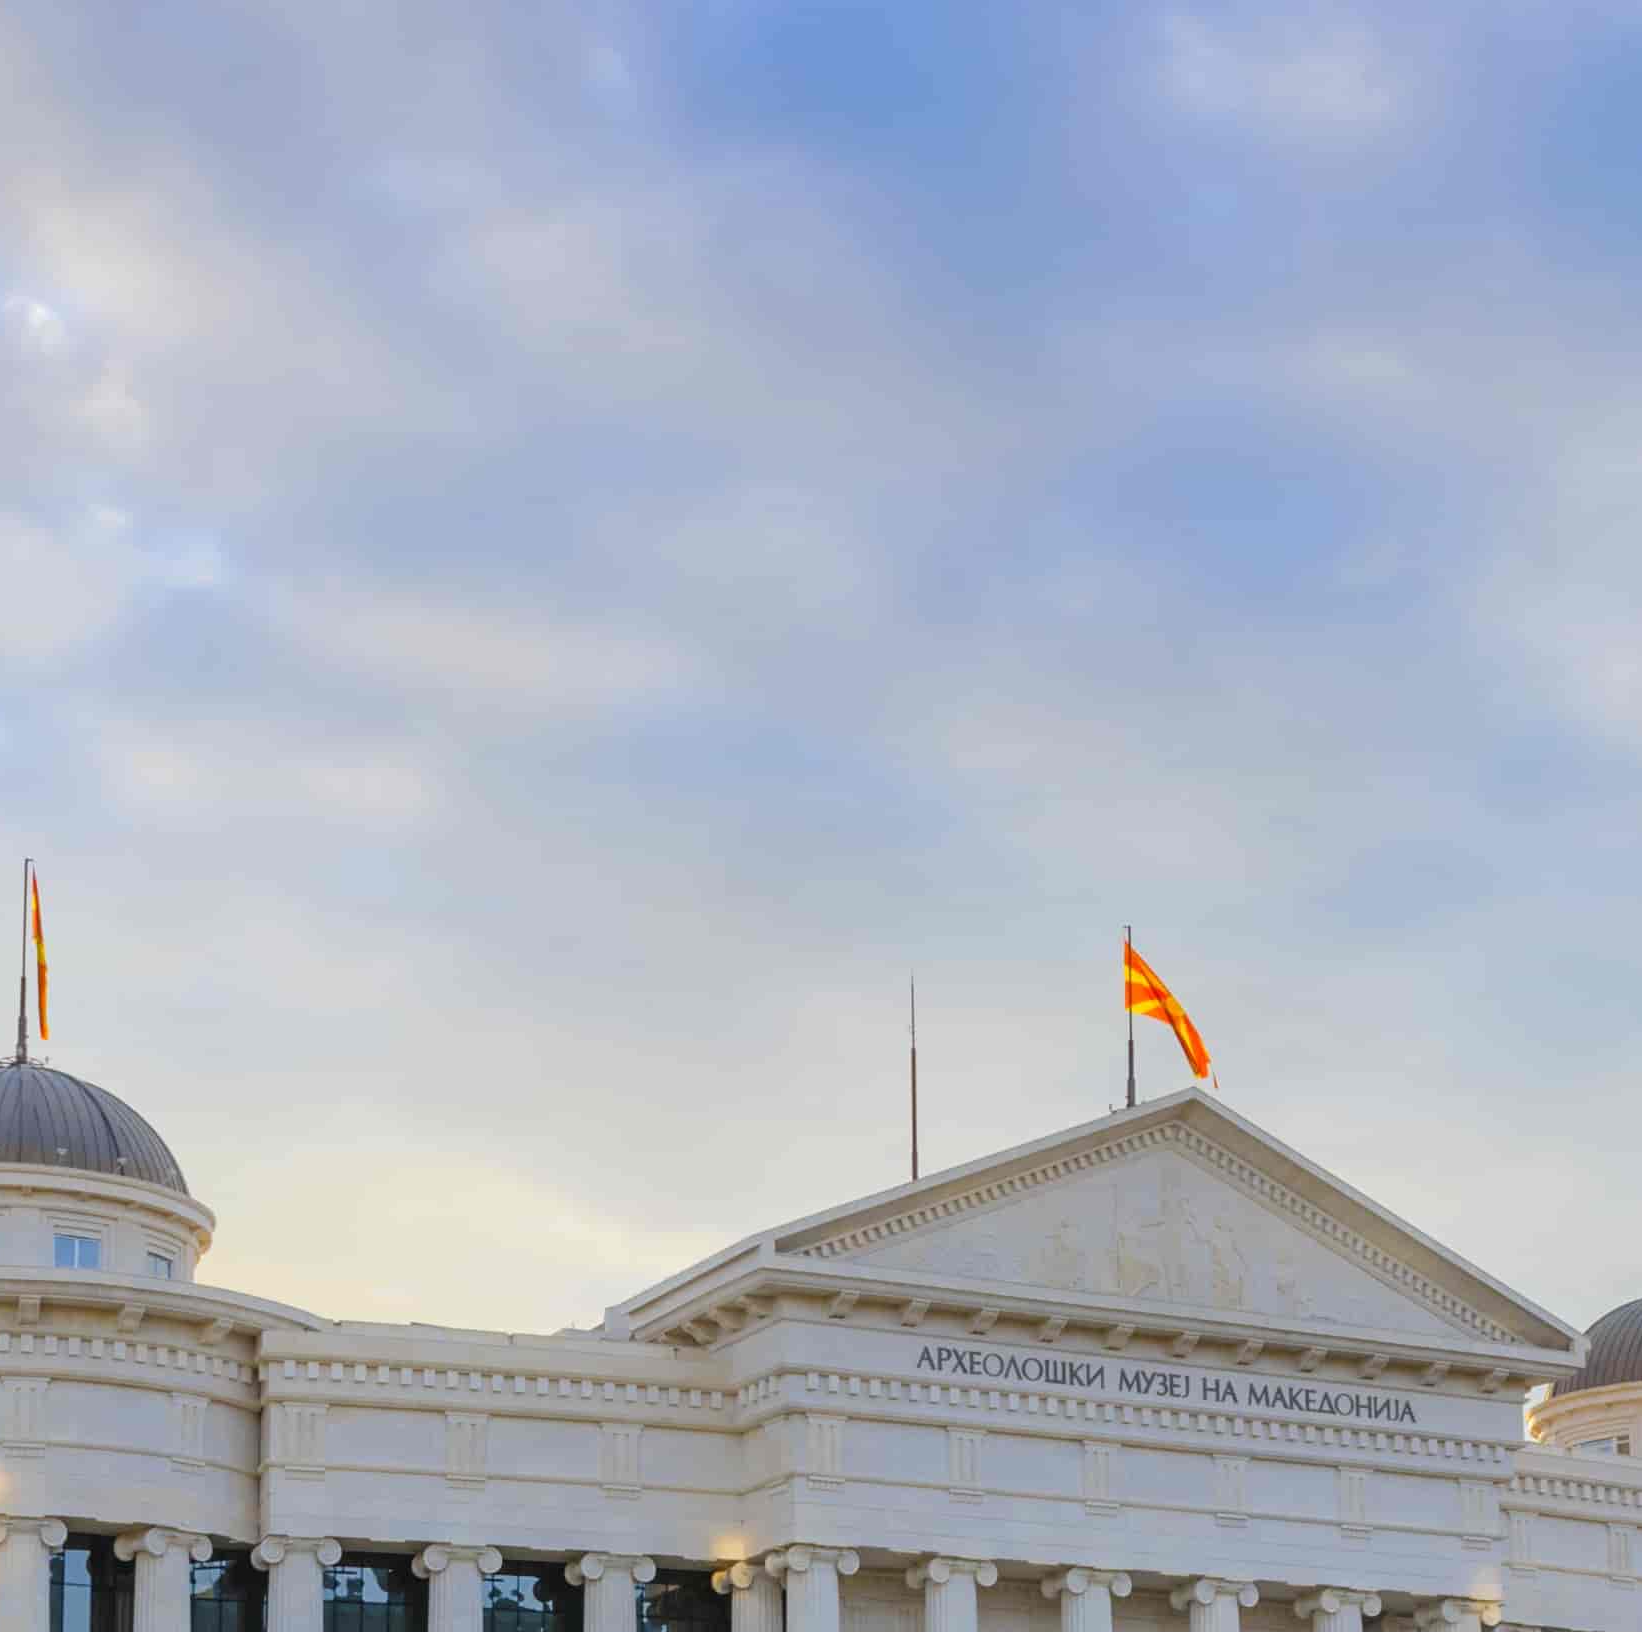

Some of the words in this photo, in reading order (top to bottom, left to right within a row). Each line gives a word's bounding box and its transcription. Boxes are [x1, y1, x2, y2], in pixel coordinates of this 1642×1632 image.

[916, 1345, 1105, 1389] АРХЕОЛОШКИ
[1119, 1367, 1189, 1398] МУЗЕЈ
[1202, 1376, 1238, 1403] НА
[1248, 1383, 1416, 1423] МАКЕДОНИЈА
